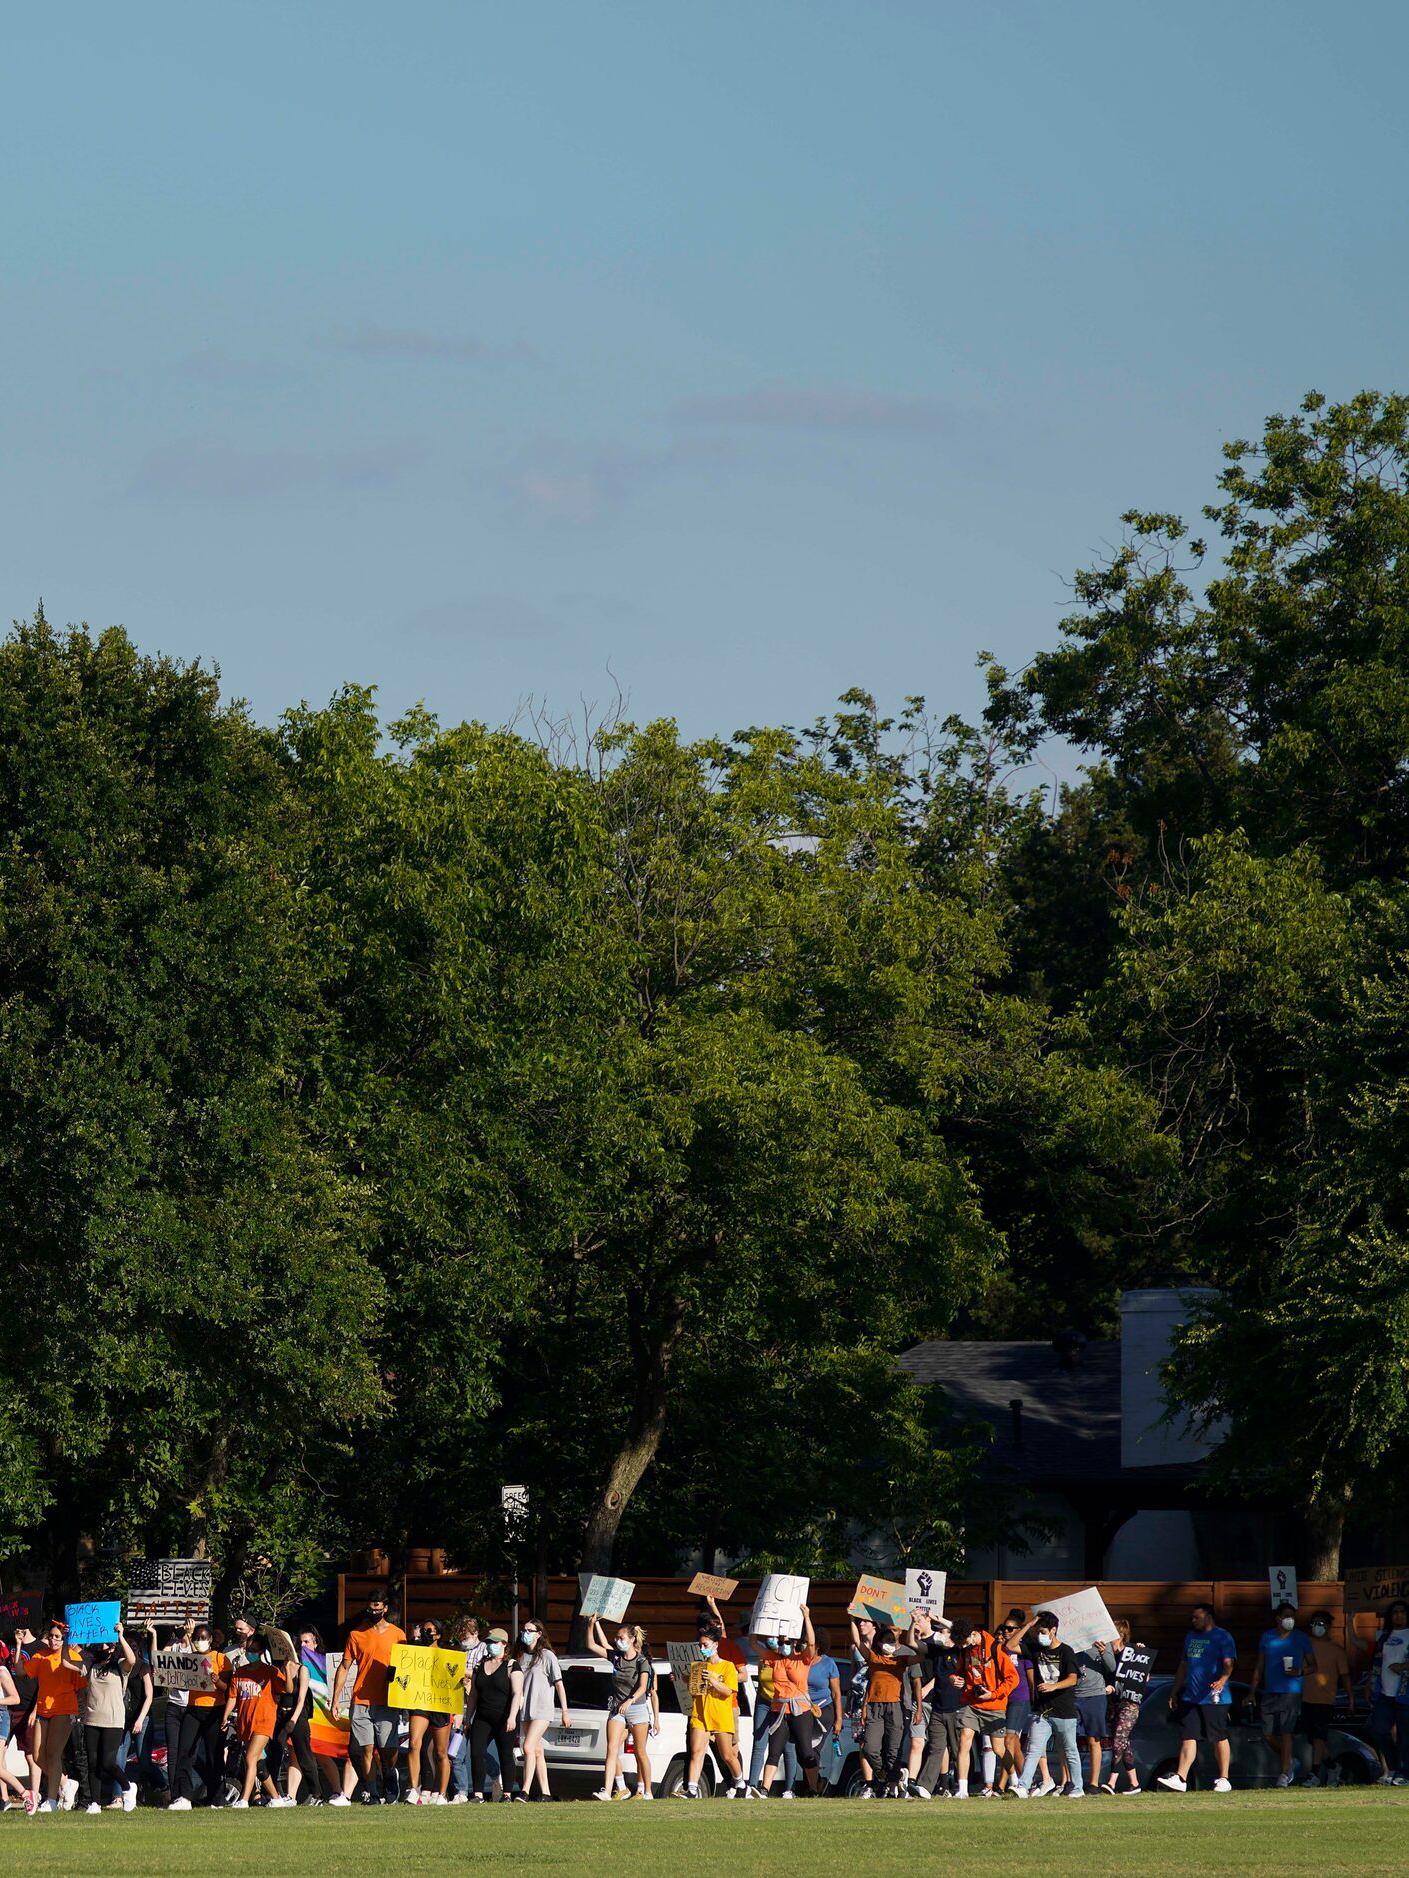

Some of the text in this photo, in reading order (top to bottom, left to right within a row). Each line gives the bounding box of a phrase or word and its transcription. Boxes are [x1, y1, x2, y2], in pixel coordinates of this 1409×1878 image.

[162, 1564, 208, 1581] BLACK
[161, 1581, 208, 1597] LIVES
[134, 1600, 207, 1617] MATTER
[157, 1655, 198, 1672] HANDS
[401, 1650, 439, 1671] Black
[423, 1672, 452, 1689] Lives
